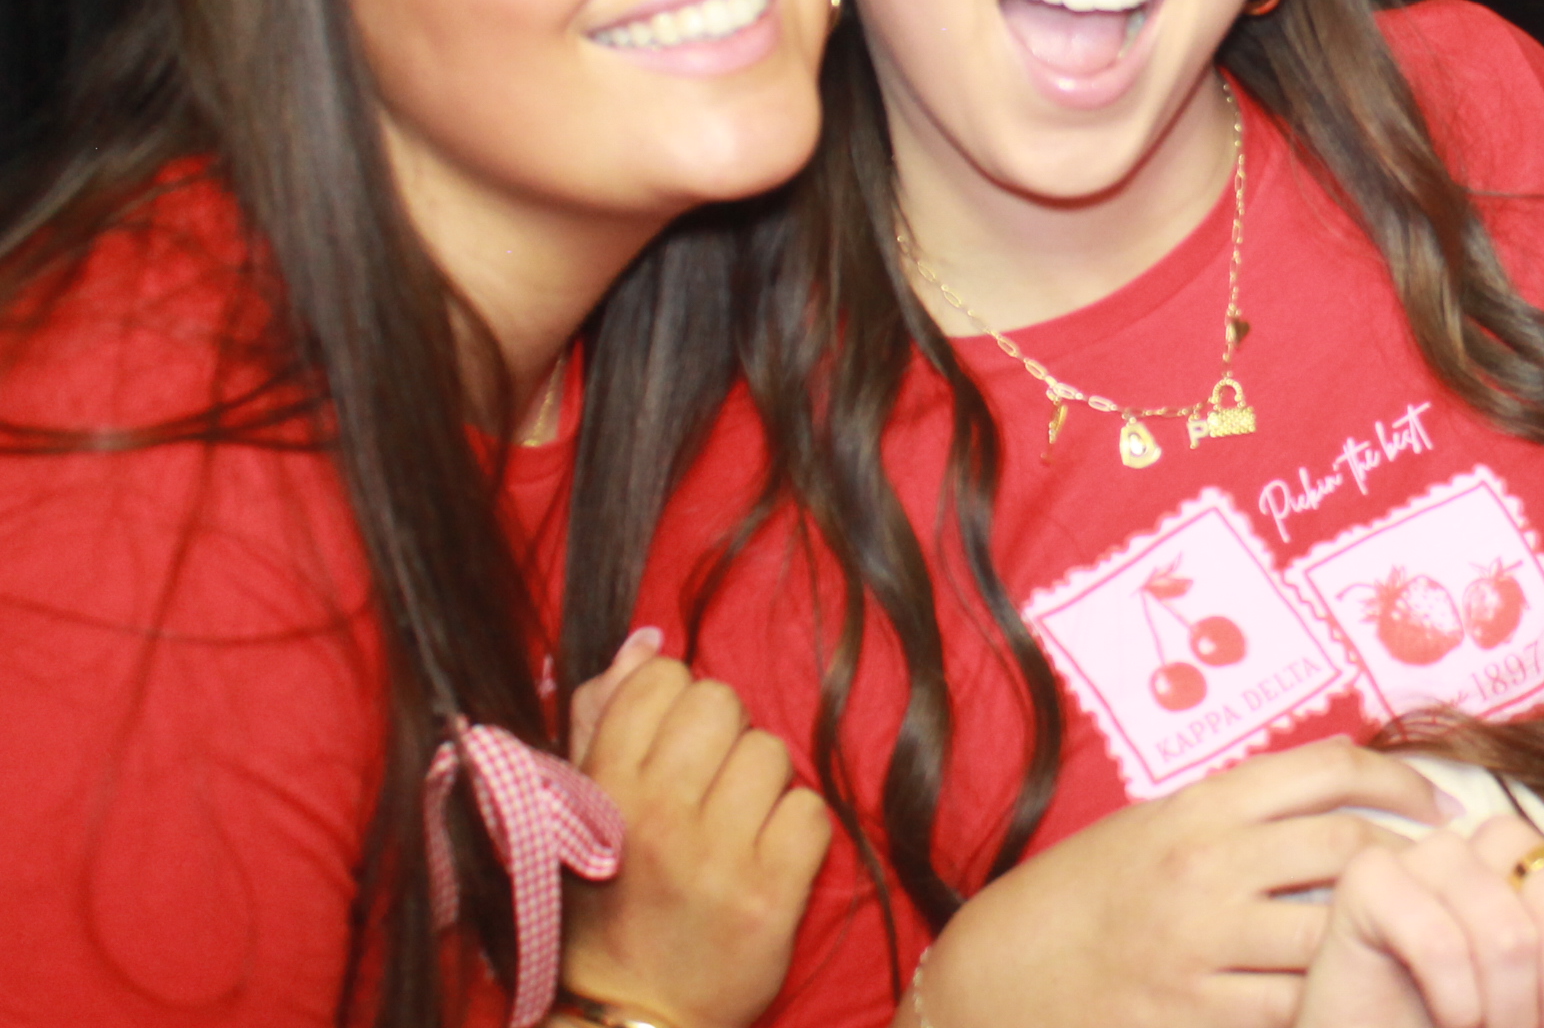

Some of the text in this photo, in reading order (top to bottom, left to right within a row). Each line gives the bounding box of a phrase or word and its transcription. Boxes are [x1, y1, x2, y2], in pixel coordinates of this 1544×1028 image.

[1336, 436, 1380, 496] the
[1374, 401, 1434, 462] best
[1155, 657, 1322, 763] KAPPA DELTA
[1471, 640, 1541, 701] 1897
